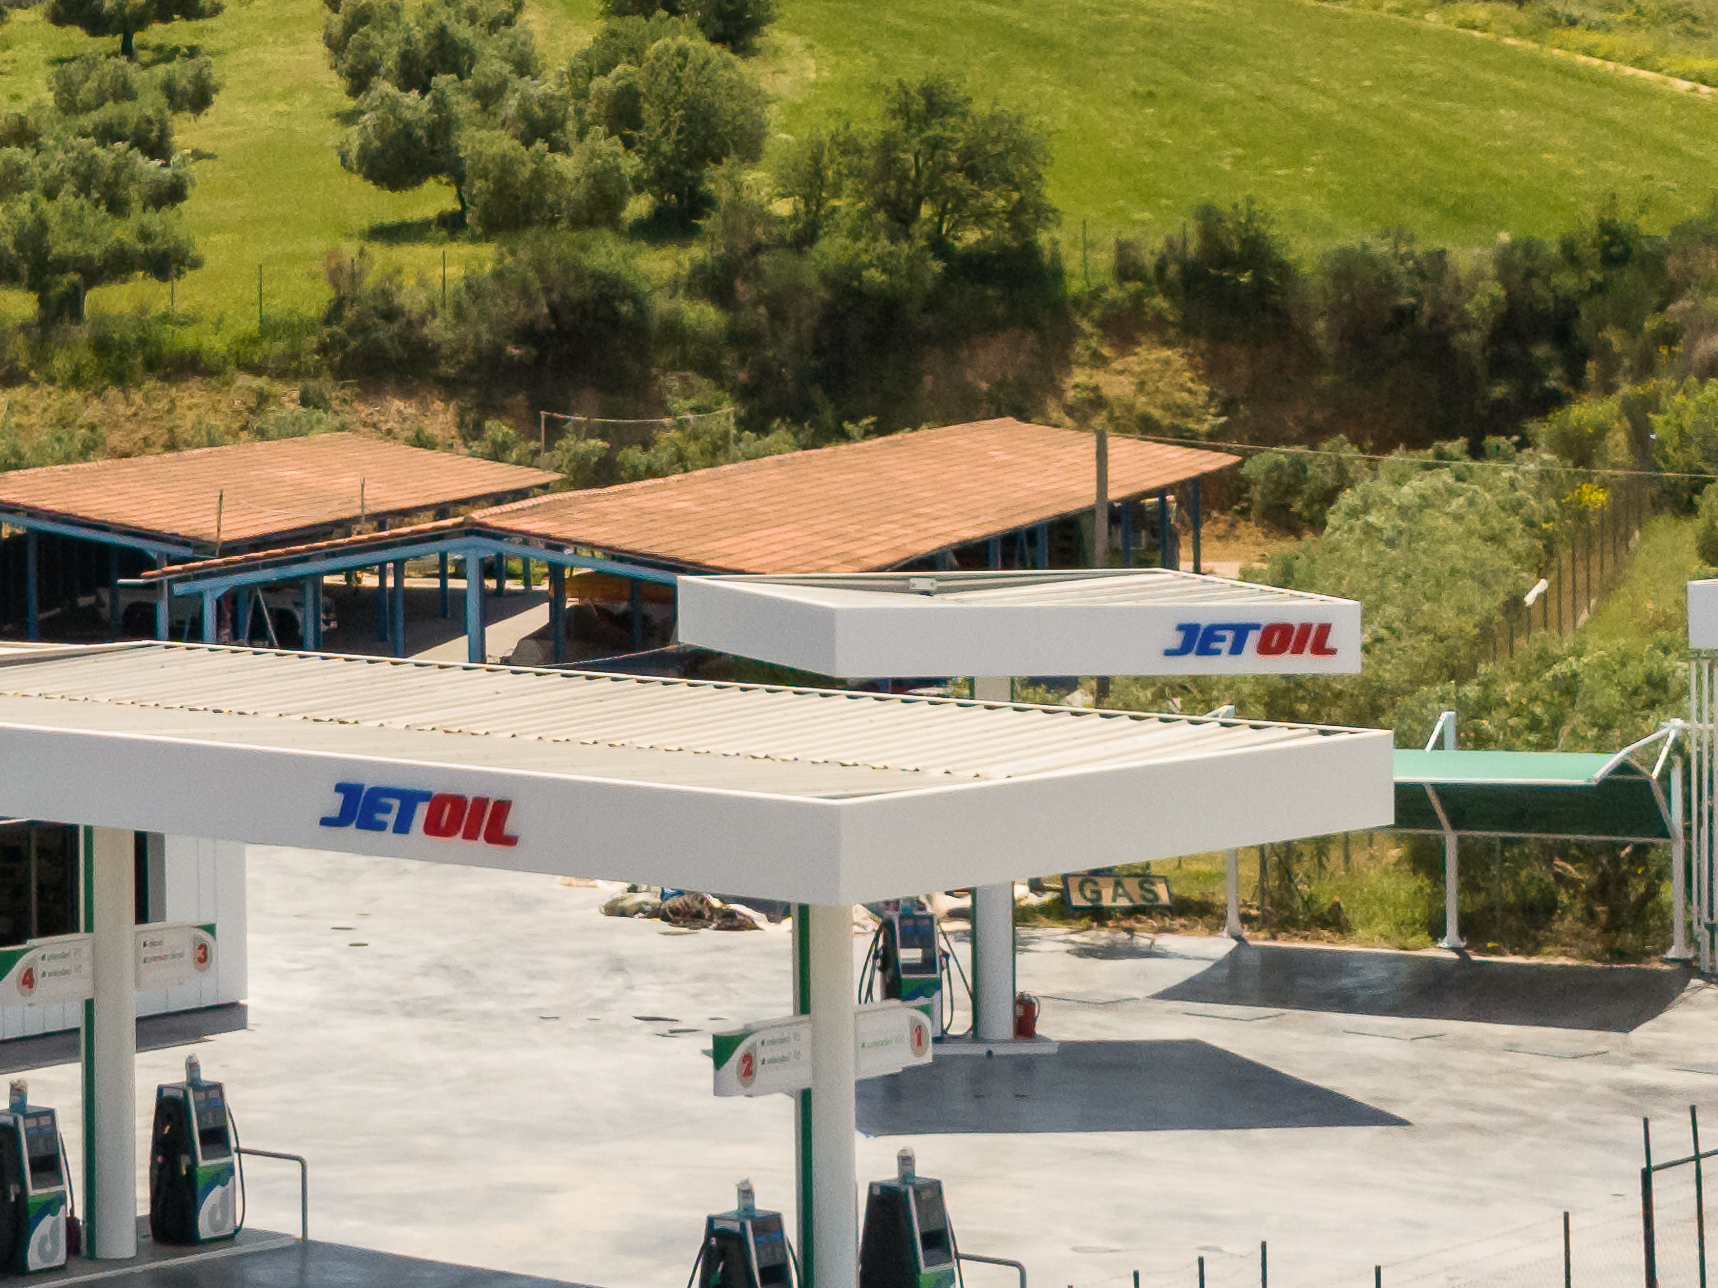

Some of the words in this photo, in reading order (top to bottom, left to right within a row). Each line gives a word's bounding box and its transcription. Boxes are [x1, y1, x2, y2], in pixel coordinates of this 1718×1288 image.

[1163, 623, 1338, 656] JETOIL
[319, 782, 519, 846] JETOIL
[1078, 877, 1160, 904] GAS
[196, 943, 208, 964] 3
[21, 967, 35, 989] 4
[913, 1025, 924, 1048] 1
[741, 1052, 753, 1079] 2
